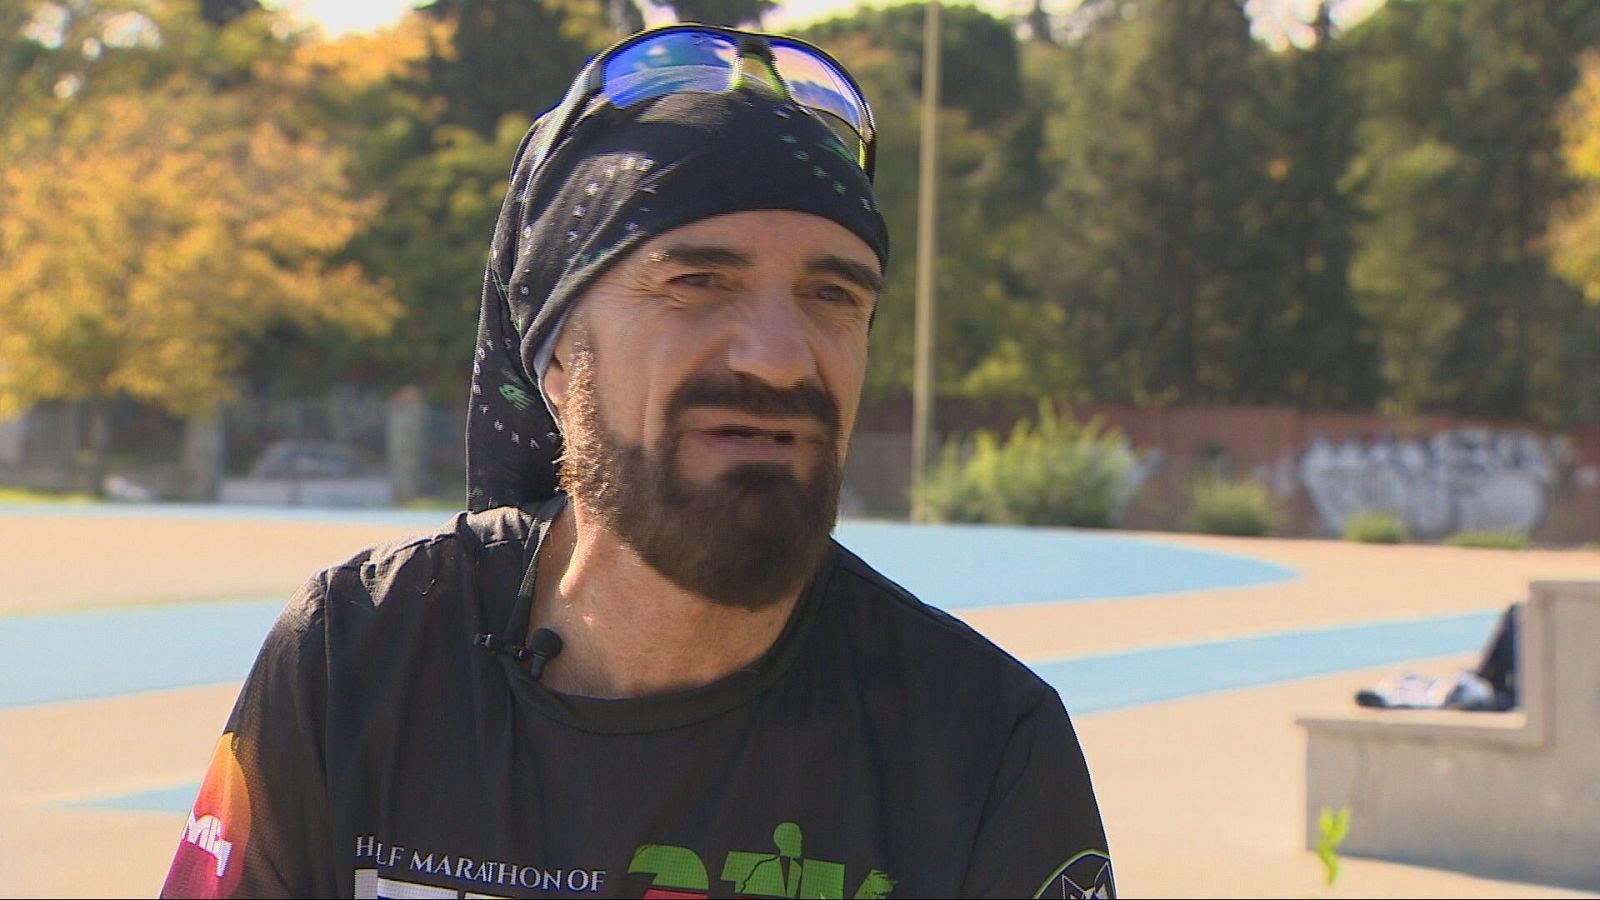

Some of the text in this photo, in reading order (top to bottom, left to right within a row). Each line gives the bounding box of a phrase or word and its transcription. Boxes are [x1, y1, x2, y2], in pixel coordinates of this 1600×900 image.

[355, 835, 405, 867] HLF
[409, 849, 562, 890] MARATHON
[566, 869, 606, 891] OF
